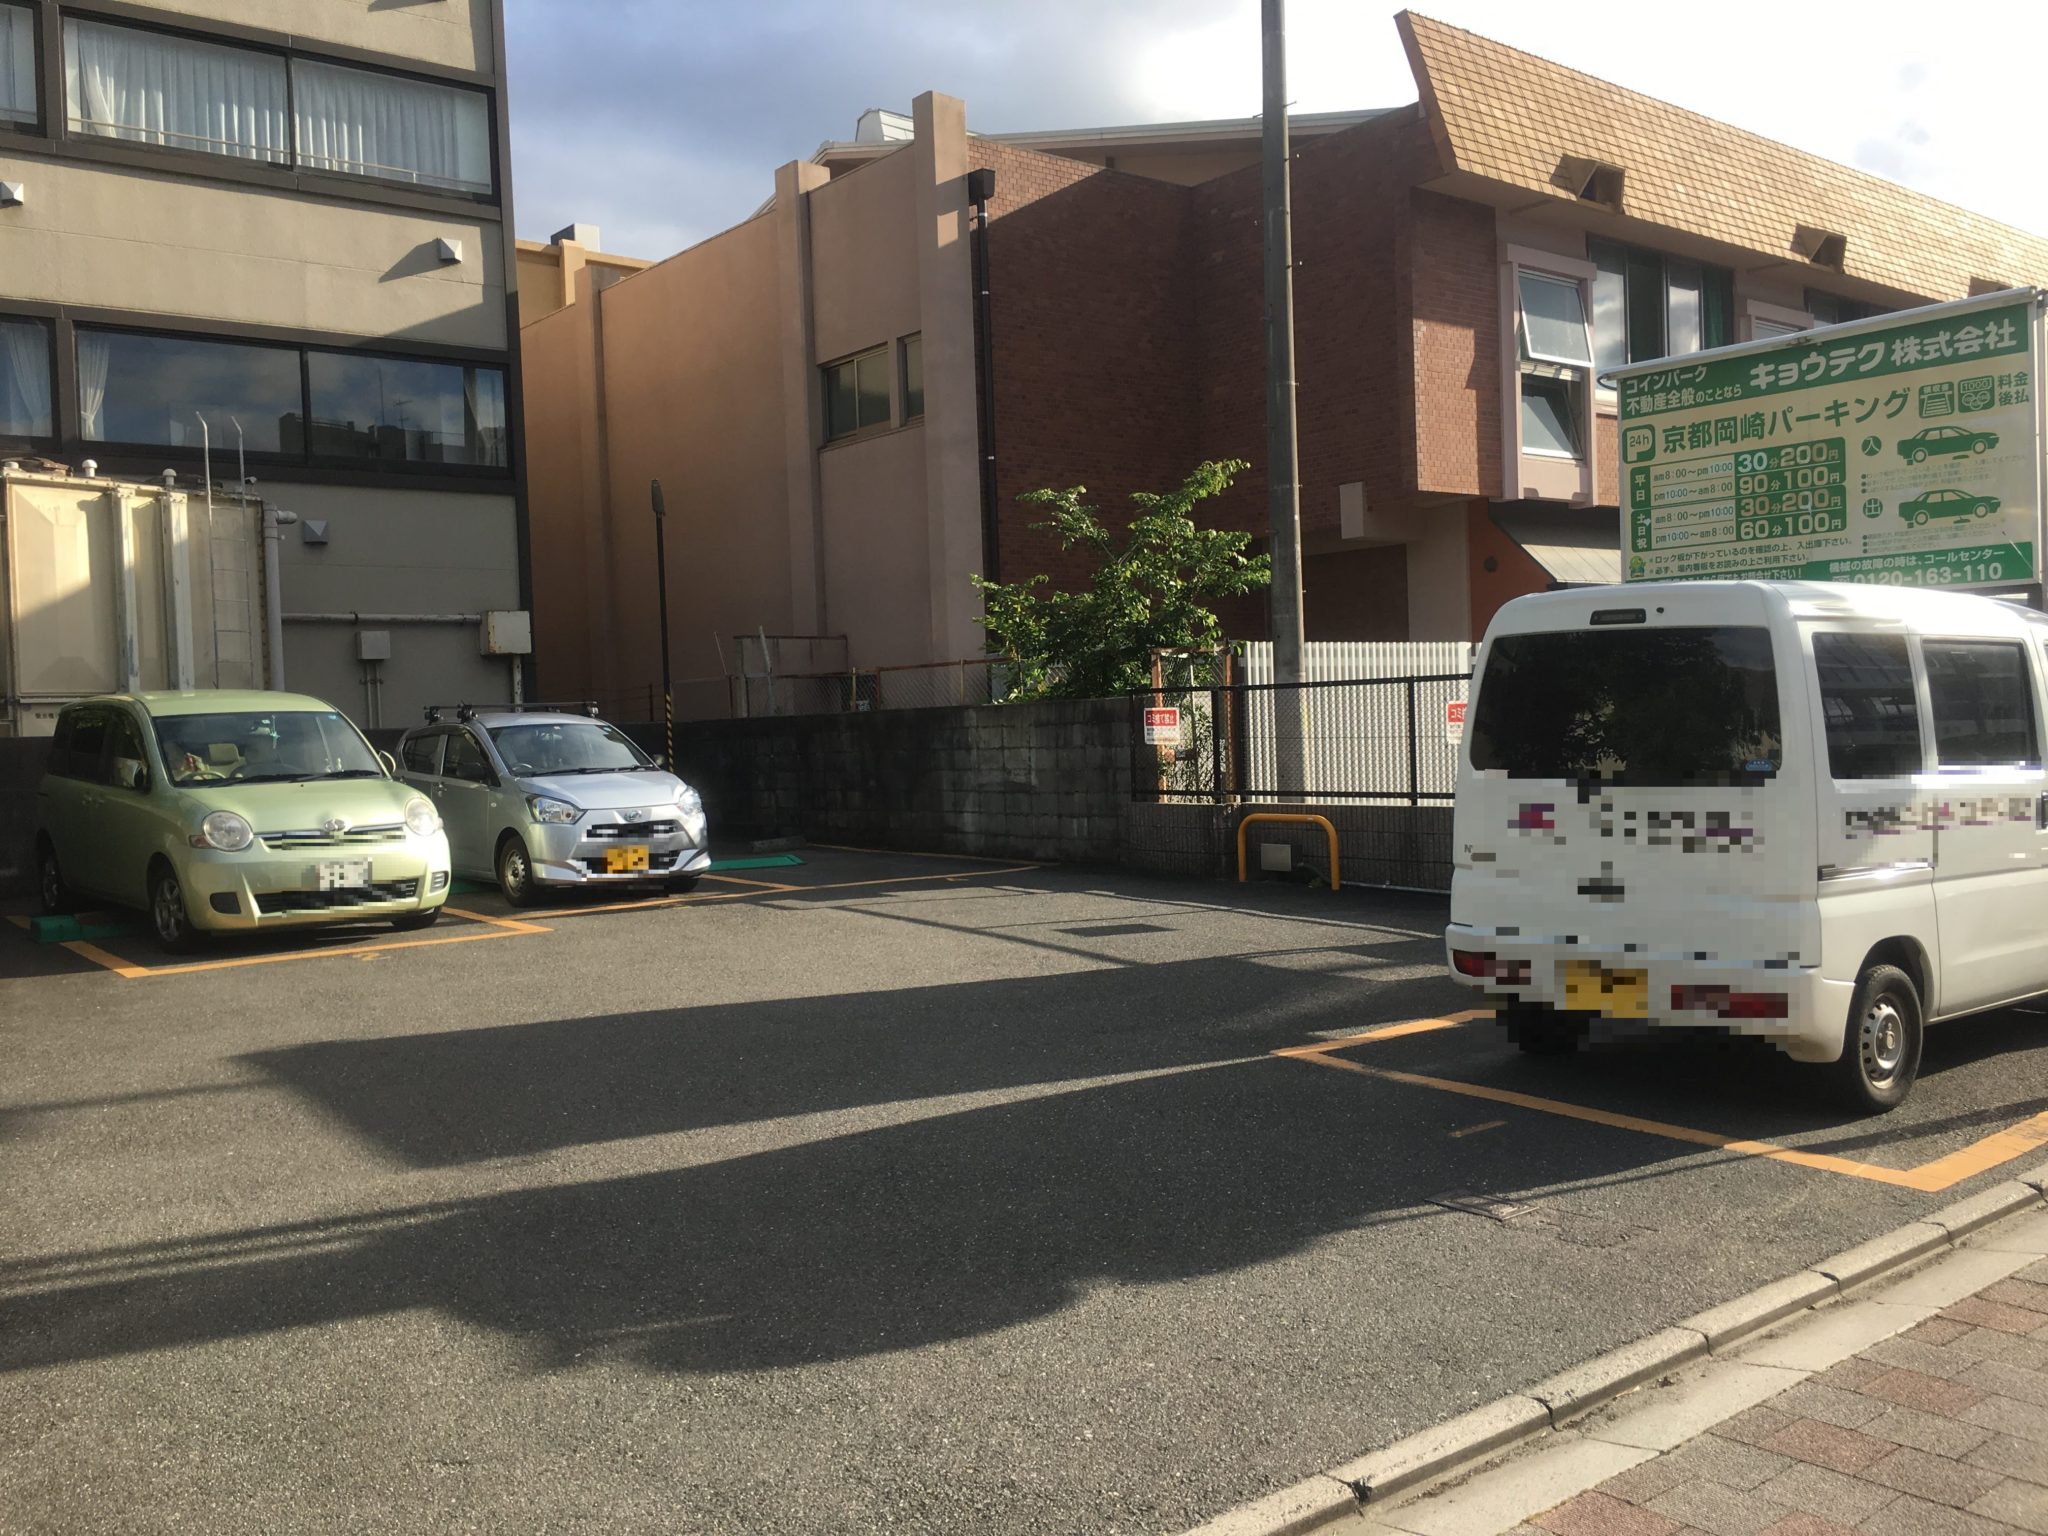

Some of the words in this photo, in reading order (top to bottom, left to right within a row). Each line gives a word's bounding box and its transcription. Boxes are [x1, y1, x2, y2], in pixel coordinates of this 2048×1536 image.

[1749, 340, 1885, 390] キョウテク
[1890, 318, 2017, 367] 株式会社
[1626, 365, 1708, 395] コインパーク
[1997, 371, 2029, 389] 料金
[1626, 383, 1742, 416] 不動産全般のことなら
[1998, 389, 2029, 406] 後払
[1662, 387, 1911, 454] 京都岡崎パーキング
[1629, 433, 1650, 448] 24h
[1865, 438, 1879, 455] 入
[1634, 474, 1646, 502] 平日
[1865, 499, 1880, 516] 出
[1635, 513, 1647, 550] 土日祝
[1853, 562, 2003, 587] 0120-163-110
